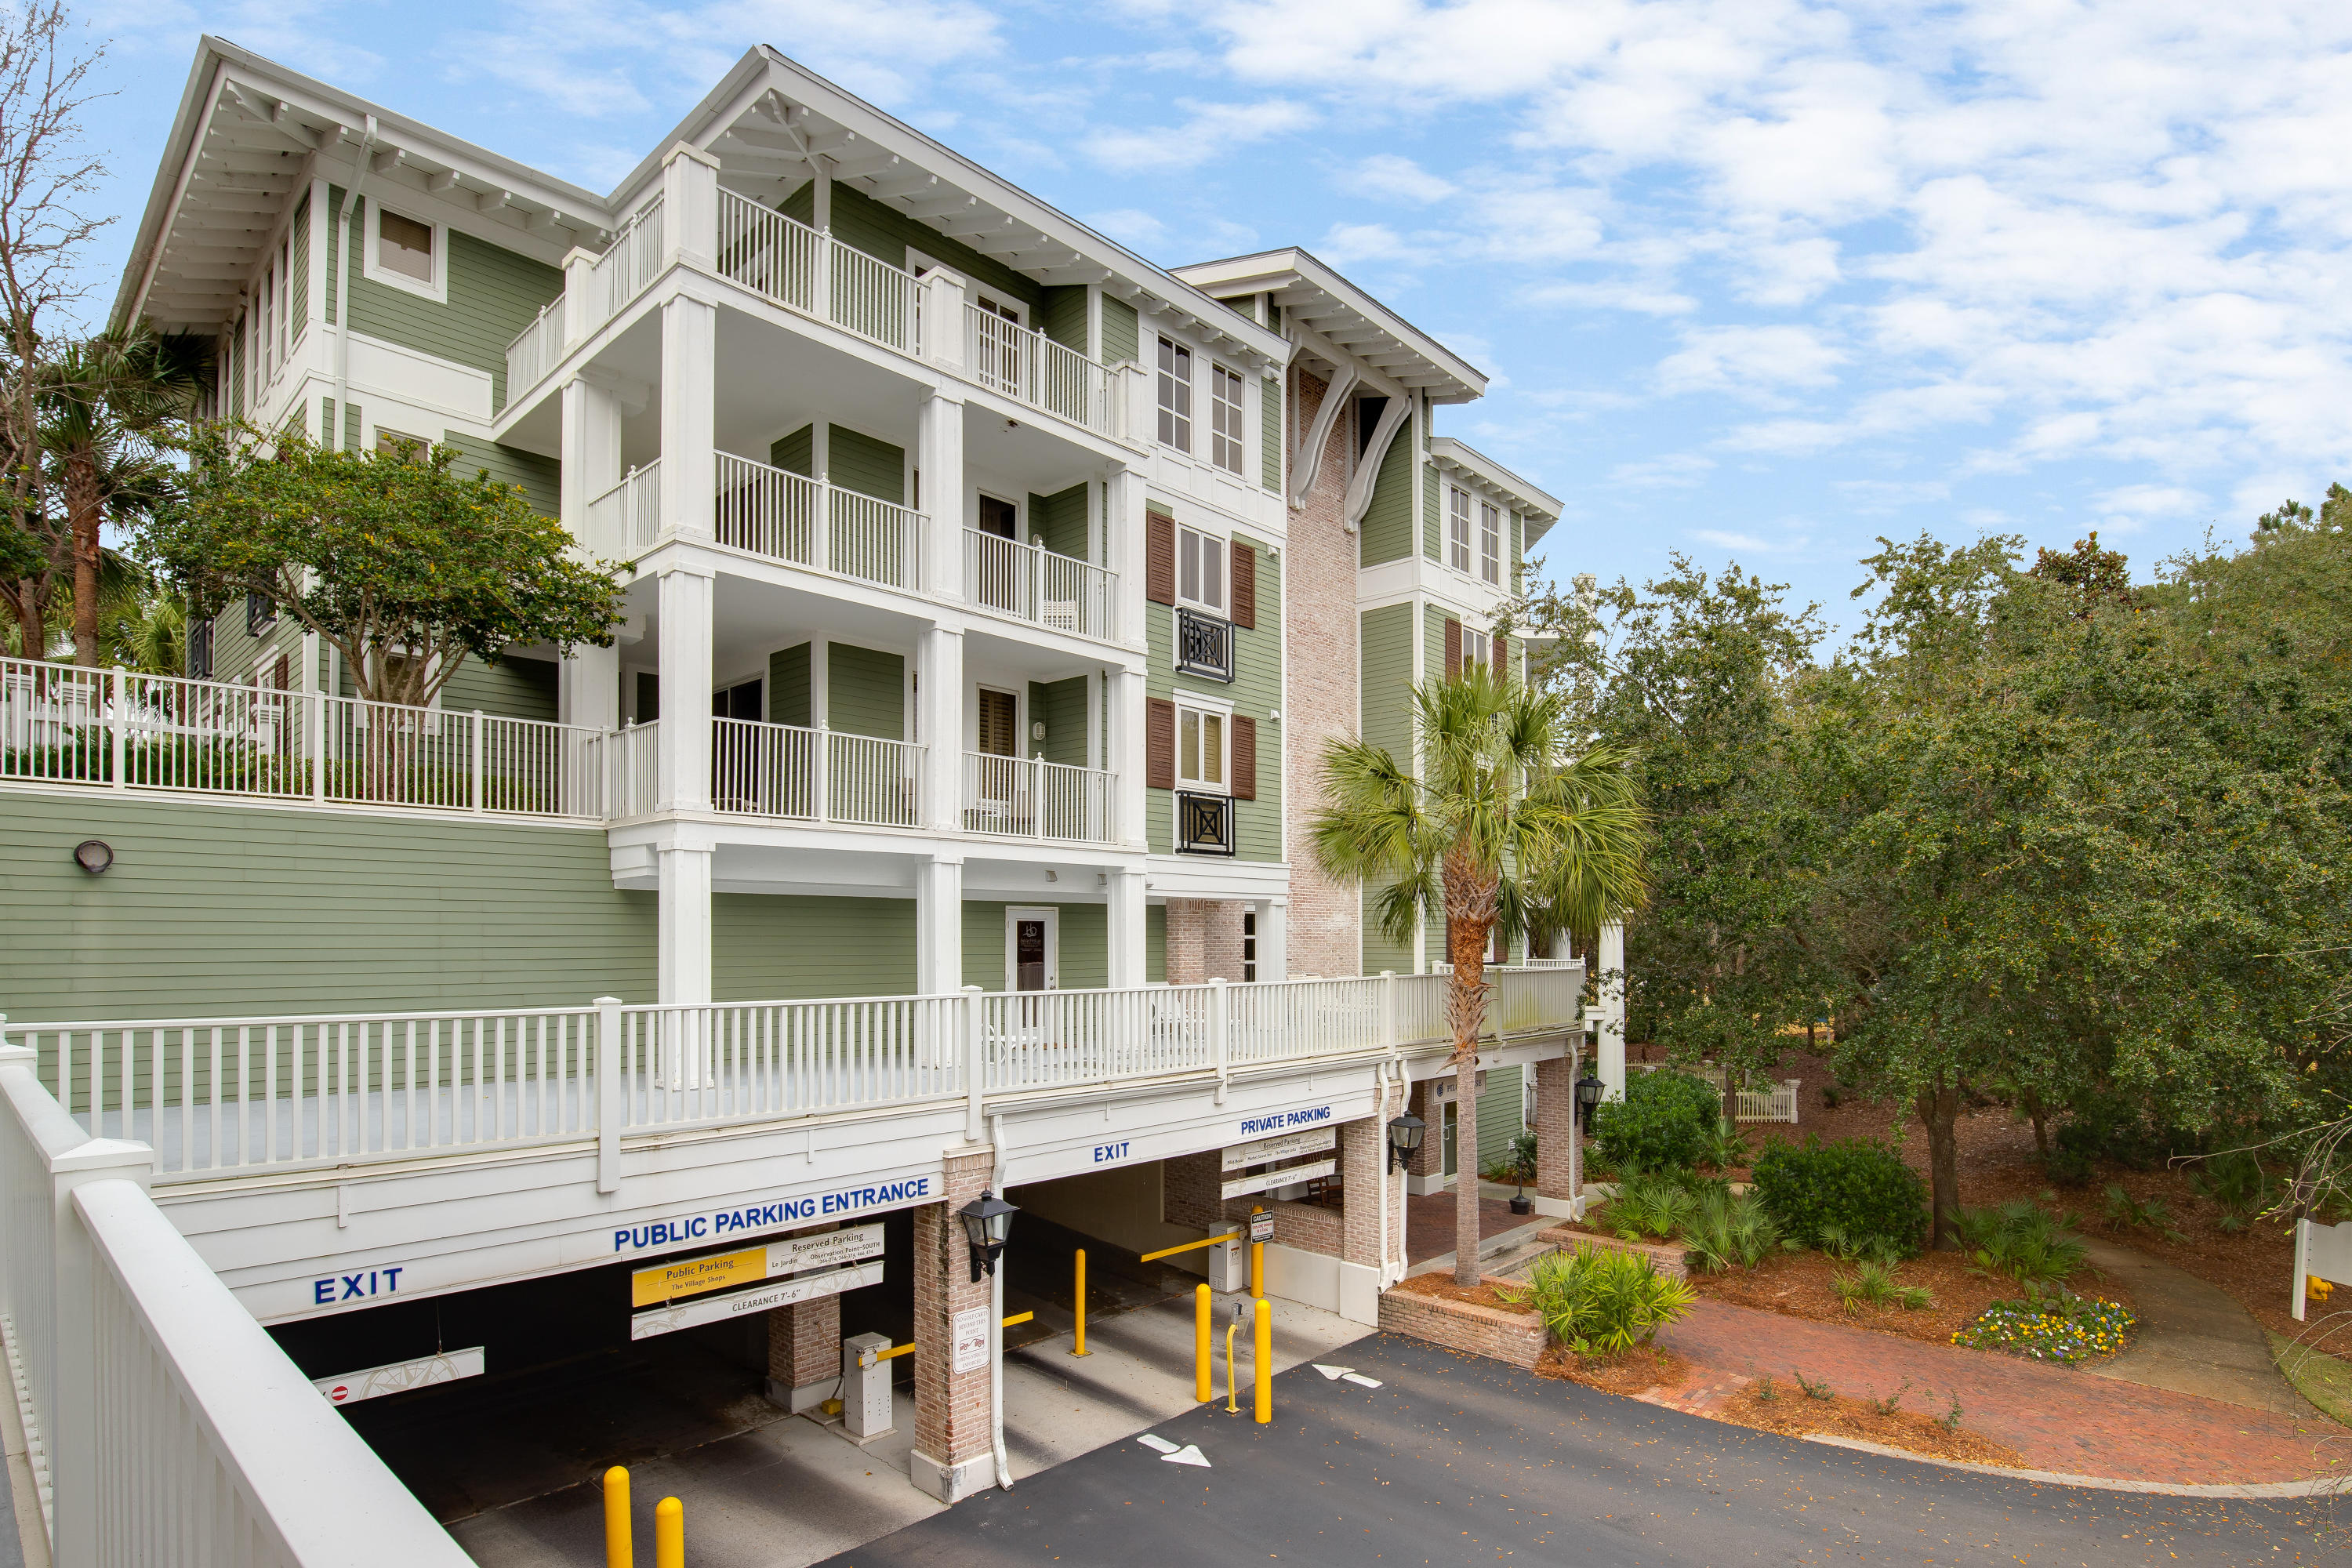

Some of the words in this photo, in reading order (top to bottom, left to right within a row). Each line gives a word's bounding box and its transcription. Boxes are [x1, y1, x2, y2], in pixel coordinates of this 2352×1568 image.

[1241, 1115, 1284, 1135] PRIVATE
[1287, 1106, 1330, 1127] PARKING
[1263, 1139, 1283, 1150] Reserved
[1284, 1137, 1301, 1146] Parking
[1094, 1142, 1130, 1163] EXIT
[1266, 1176, 1288, 1186] CLEARANCE
[615, 1216, 708, 1253] PUBLIC
[715, 1197, 816, 1234] PARKING
[822, 1178, 930, 1214] ENTRANCE
[1253, 1213, 1272, 1221] CAUTION
[792, 1237, 829, 1253] Reserved
[833, 1232, 864, 1243] Parking
[810, 1249, 844, 1261] Observation
[666, 1266, 695, 1280] Public
[699, 1259, 735, 1273] Parking
[780, 1258, 798, 1268] Jardin
[314, 1267, 403, 1305] EXIT
[684, 1279, 706, 1287] Village
[732, 1294, 779, 1312] CLEARANCE
[958, 1322, 976, 1330] BEYOND
